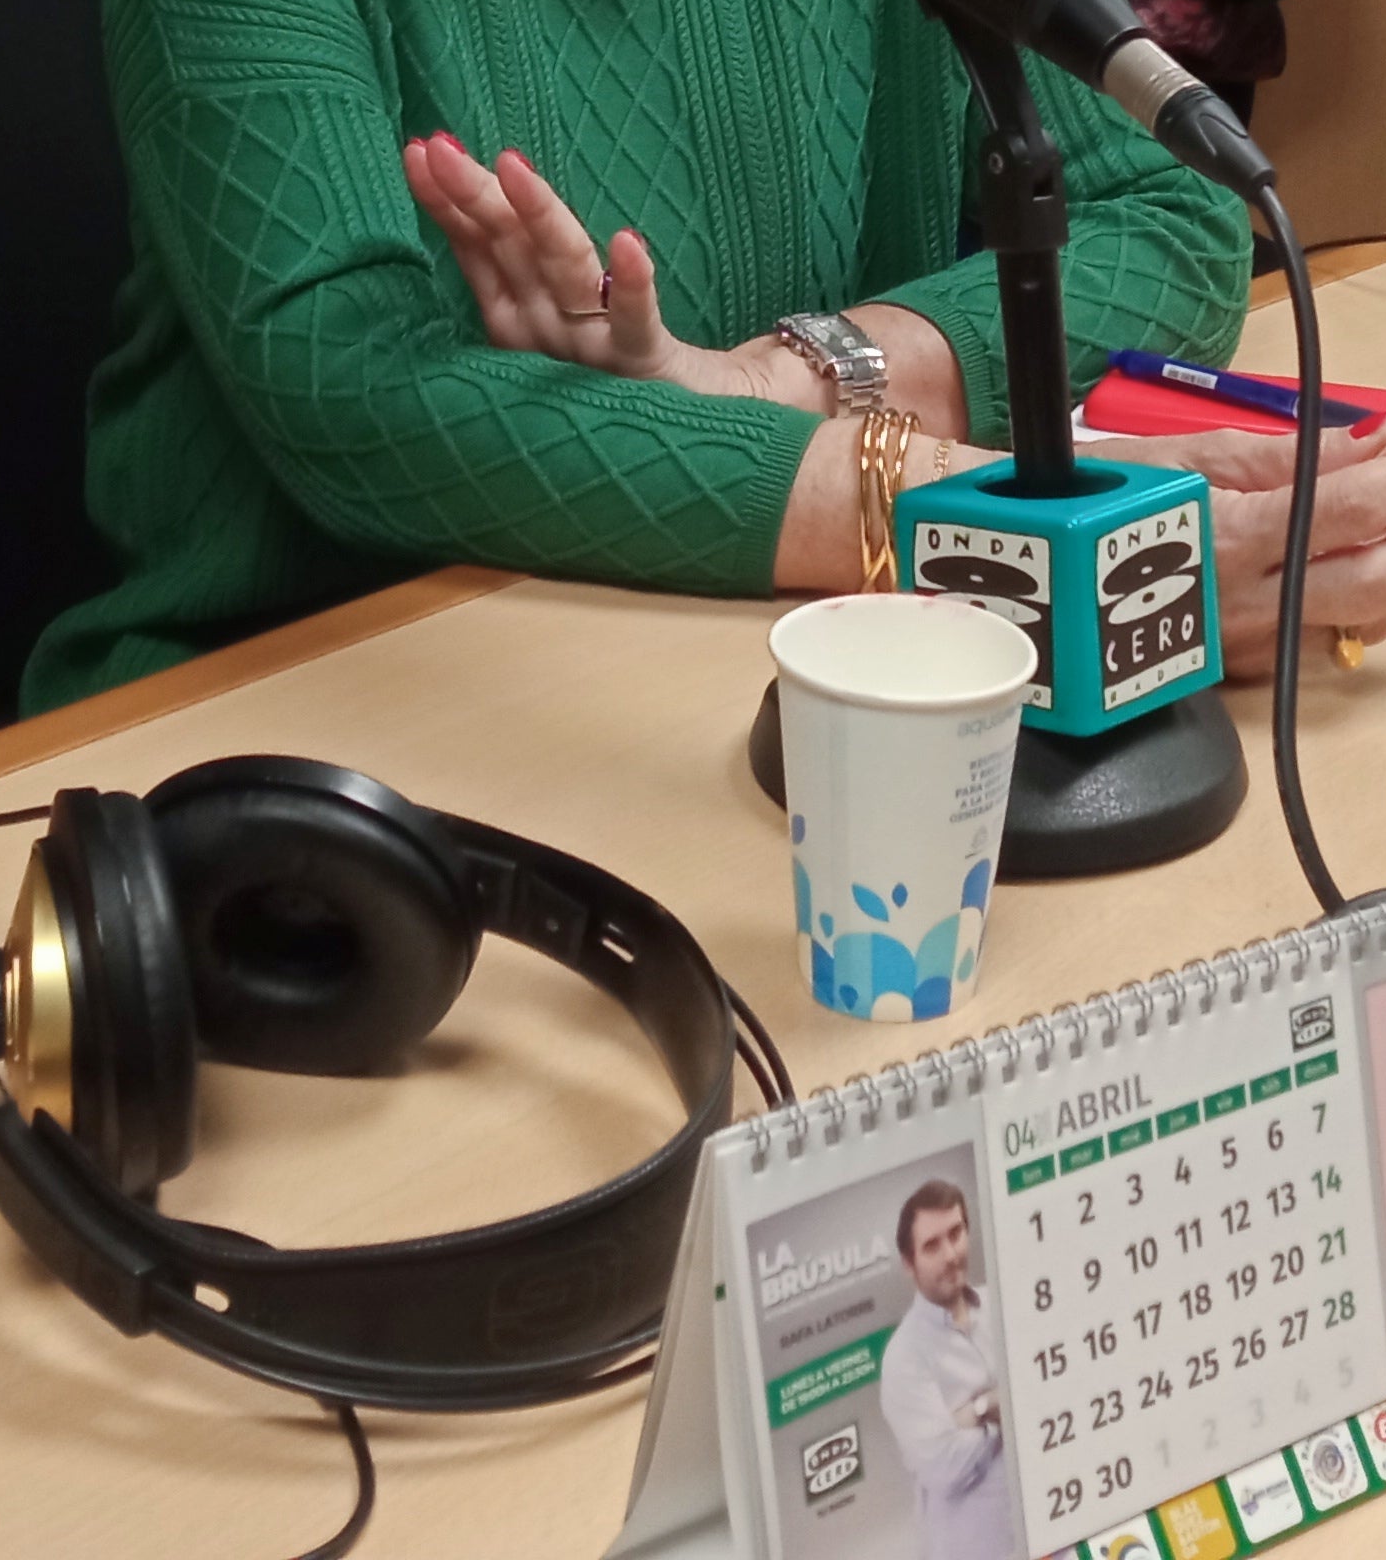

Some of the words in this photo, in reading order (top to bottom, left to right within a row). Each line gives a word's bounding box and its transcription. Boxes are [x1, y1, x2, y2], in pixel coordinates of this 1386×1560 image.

[926, 527, 1034, 561] ONDA
[1107, 510, 1190, 561] ONDA
[1105, 612, 1195, 672] CERO
[1004, 1120, 1036, 1158] 04
[1056, 1072, 1153, 1138] ABRIL
[1029, 1211, 1043, 1241] 1
[1078, 1192, 1096, 1225] 2
[1126, 1173, 1144, 1205] 3
[1174, 1156, 1192, 1185] 4
[1221, 1137, 1238, 1168] 5
[1267, 1120, 1285, 1151] 6
[1312, 1103, 1327, 1133] 7
[758, 1240, 796, 1276] LA
[1034, 1278, 1053, 1311] 8
[1083, 1258, 1102, 1292] 9
[1124, 1236, 1158, 1275] 10
[1174, 1218, 1203, 1253] 11
[1220, 1199, 1252, 1235] 12
[1266, 1181, 1297, 1217] 13
[1311, 1165, 1342, 1199] 14
[1033, 1342, 1068, 1382] 15
[1082, 1322, 1117, 1361] 16
[1132, 1301, 1163, 1340] 17
[1178, 1283, 1213, 1321] 18
[1225, 1263, 1258, 1301] 19
[1271, 1245, 1304, 1284] 20
[1317, 1226, 1347, 1265] 21
[1039, 1411, 1076, 1453] 22
[1089, 1389, 1124, 1430] 23
[1137, 1370, 1174, 1410] 24
[1185, 1347, 1220, 1390] 25
[1231, 1327, 1266, 1369] 26
[1279, 1309, 1309, 1348] 27
[1322, 1290, 1357, 1330] 28
[809, 1439, 852, 1471] ONDA
[1046, 1477, 1084, 1521] 29
[1096, 1456, 1132, 1499] 30
[1203, 1418, 1220, 1452] 2
[1249, 1397, 1264, 1428] 3
[1338, 1355, 1355, 1389] 5
